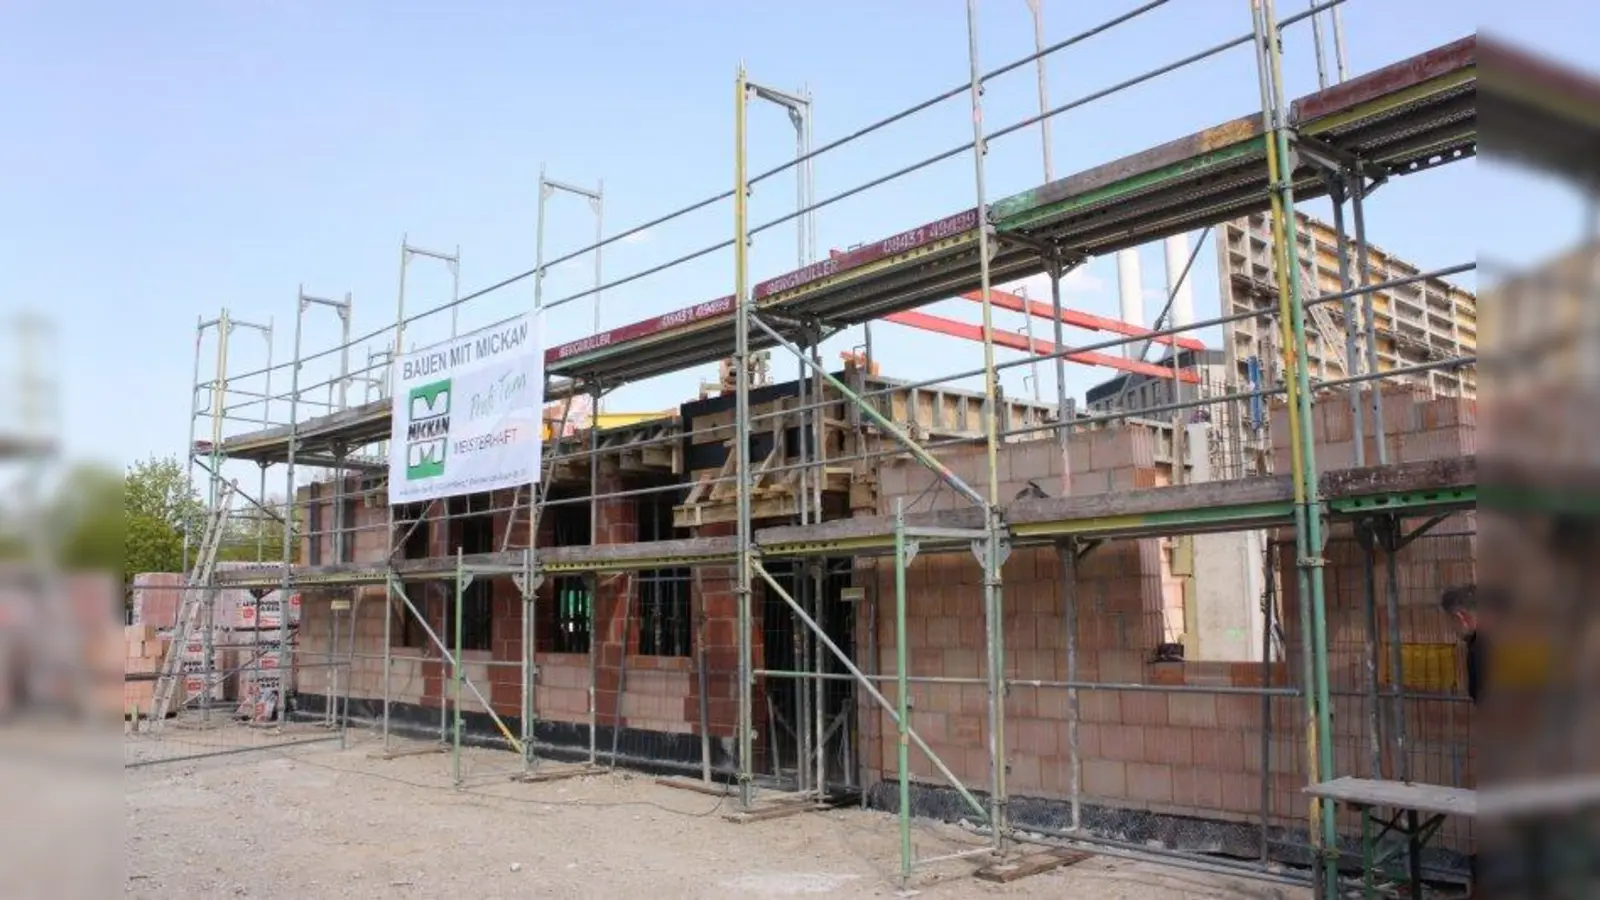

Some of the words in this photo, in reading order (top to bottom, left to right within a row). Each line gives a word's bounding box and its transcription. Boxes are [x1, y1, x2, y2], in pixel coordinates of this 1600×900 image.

[403, 352, 447, 380] BAUEN
[450, 342, 472, 368] MIT
[475, 321, 528, 359] MICKAN
[406, 416, 450, 441] MICKAN
[453, 428, 518, 455] MEISTERHAFT
